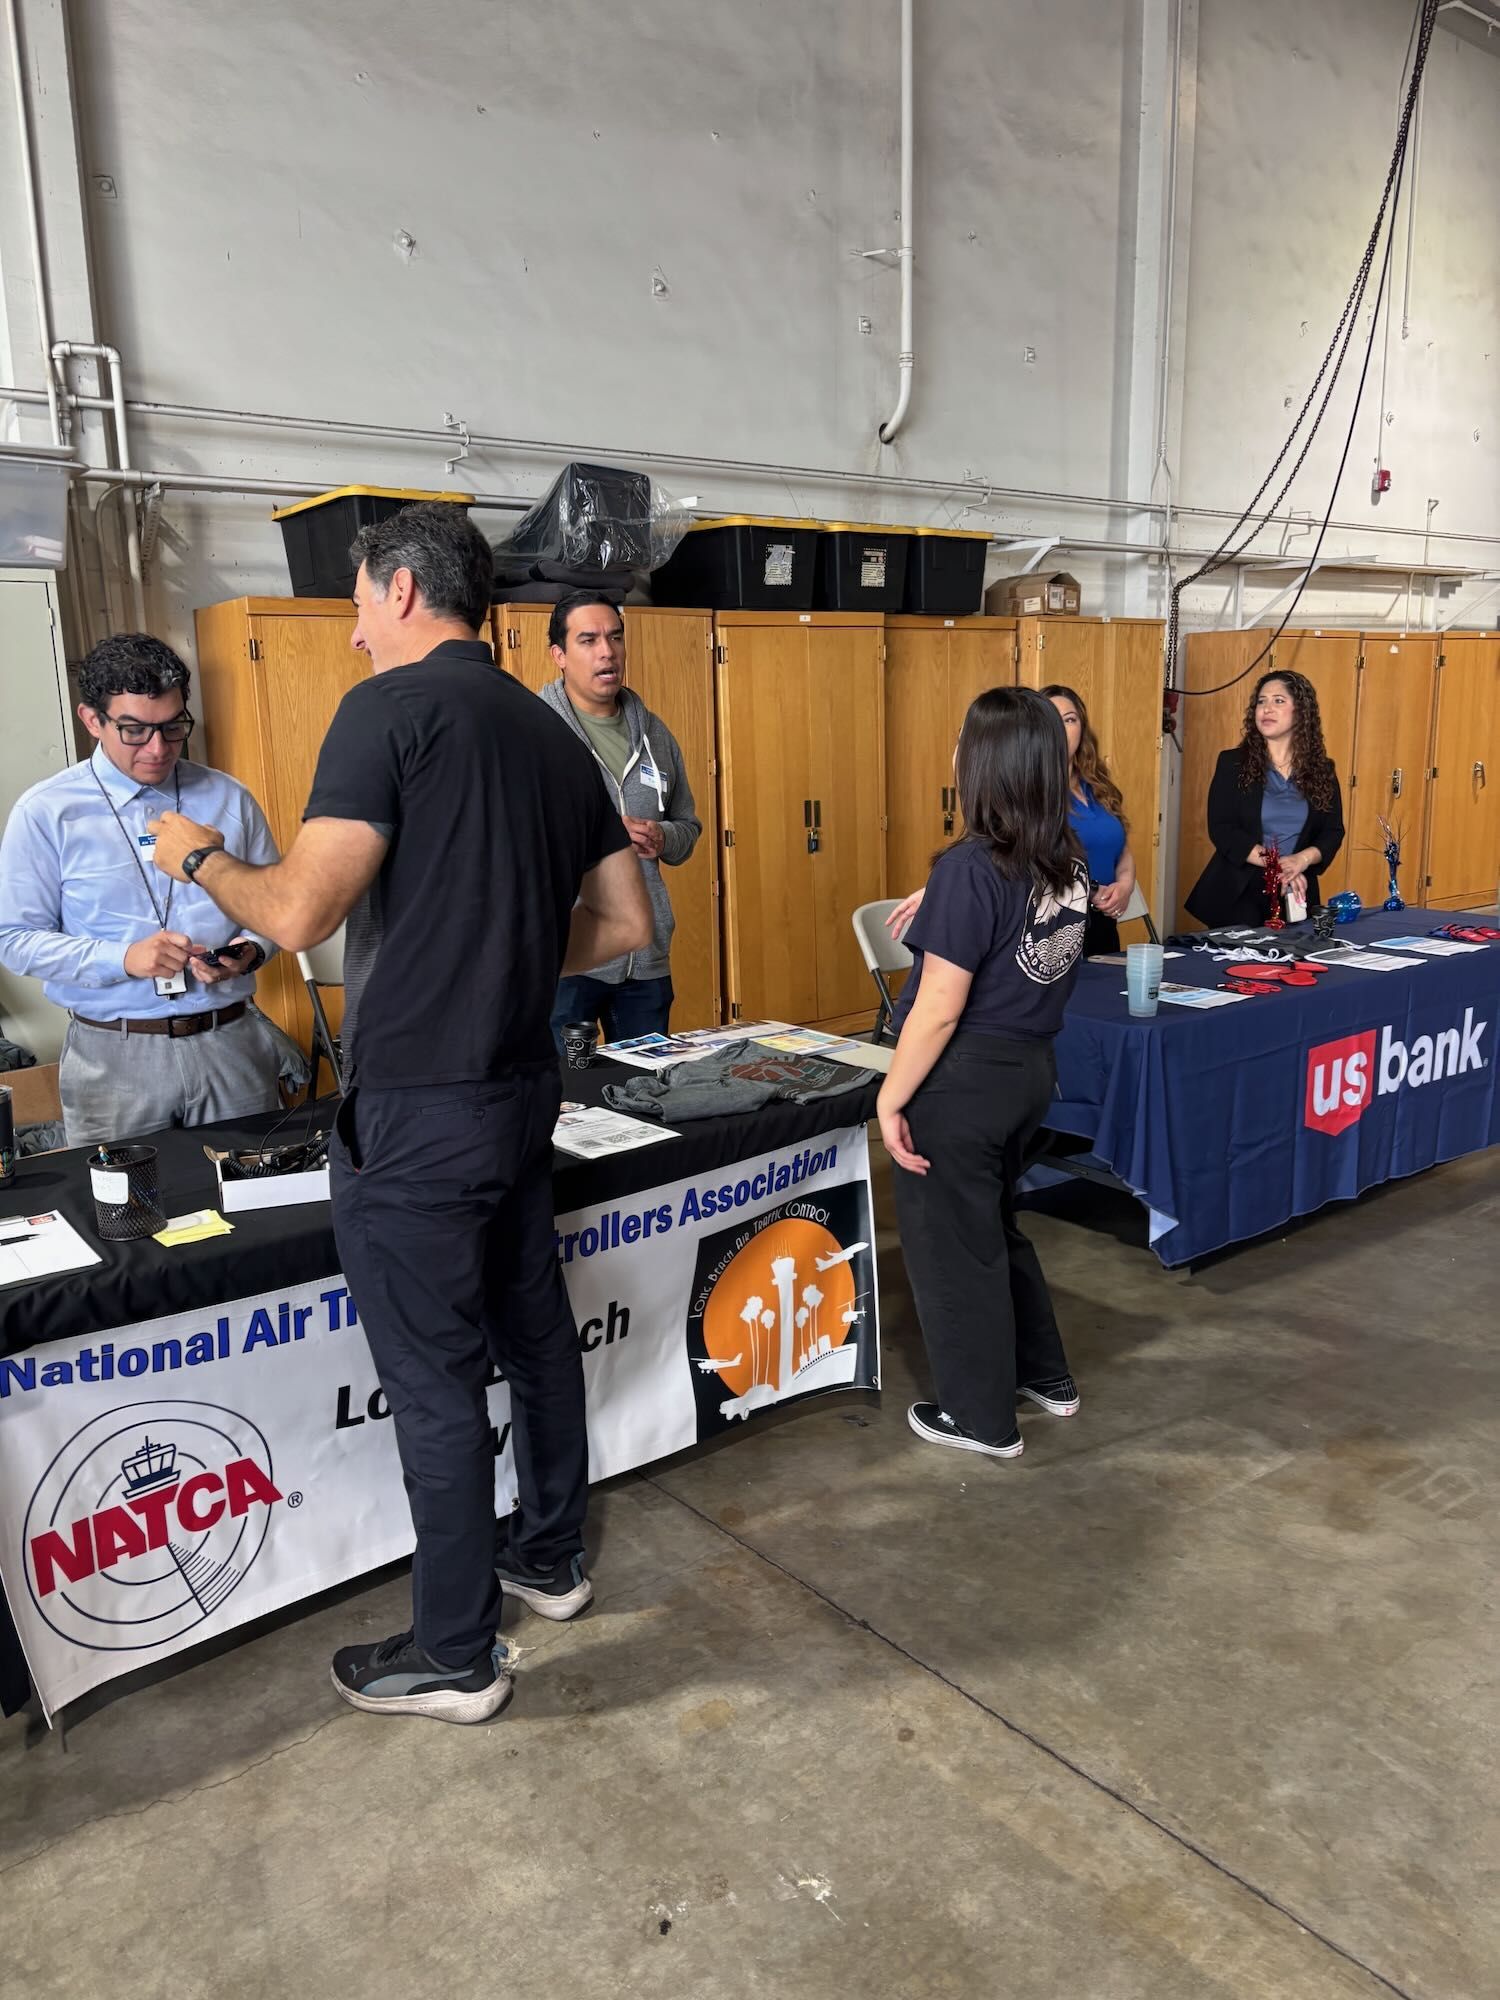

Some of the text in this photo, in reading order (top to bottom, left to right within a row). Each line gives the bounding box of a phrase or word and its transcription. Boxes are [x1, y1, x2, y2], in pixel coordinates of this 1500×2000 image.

[1378, 1006, 1488, 1096] bank
[785, 1201, 831, 1226] CONTROL
[0, 1317, 231, 1399] National
[242, 1302, 313, 1354] Air
[553, 1203, 673, 1265] trollers
[679, 1144, 838, 1226] Association
[31, 1457, 284, 1598] NATCA
